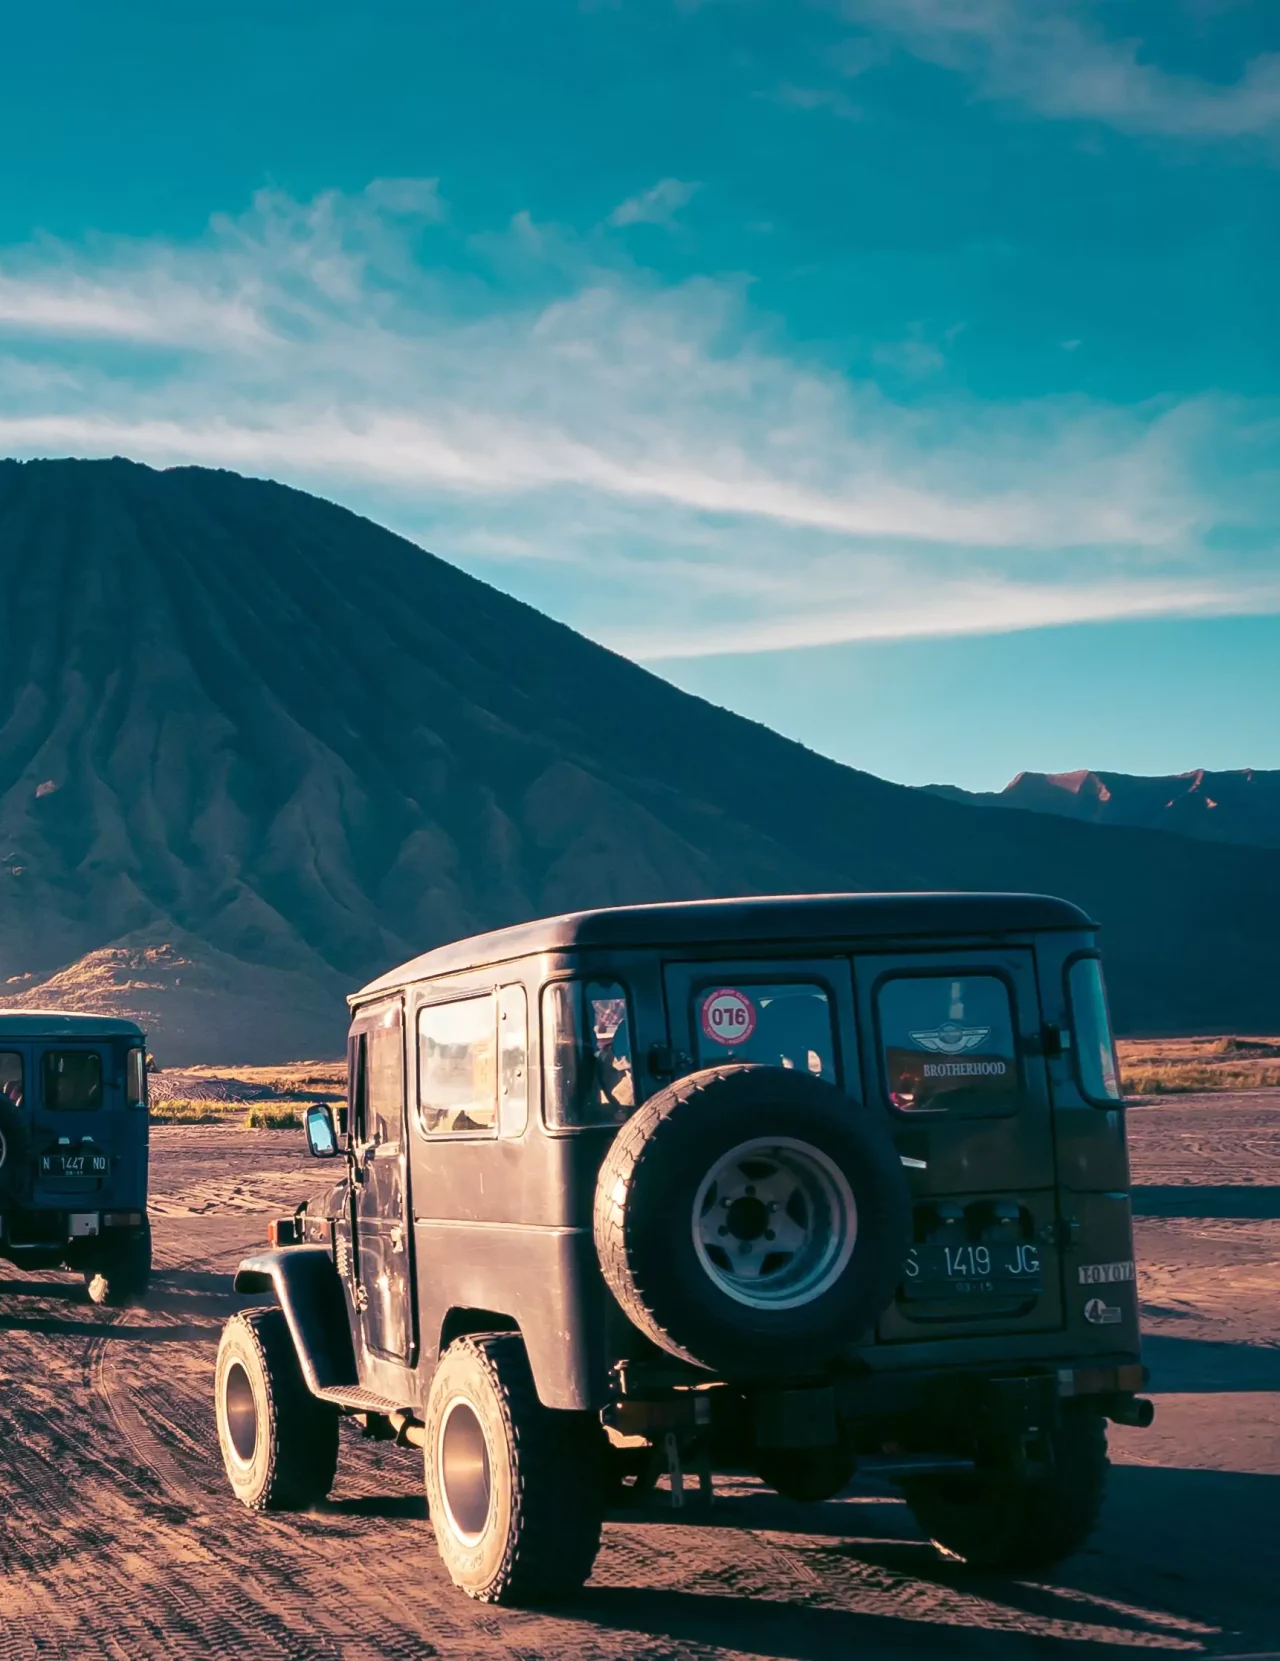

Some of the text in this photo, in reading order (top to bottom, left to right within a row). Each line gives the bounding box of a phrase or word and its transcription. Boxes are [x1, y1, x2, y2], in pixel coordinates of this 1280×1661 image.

[712, 1007, 746, 1026] 076
[923, 1061, 1006, 1077] BROTHERHOOD
[43, 1156, 50, 1170] N
[61, 1156, 85, 1170] 1447
[905, 1244, 1041, 1277] S 1419 JG
